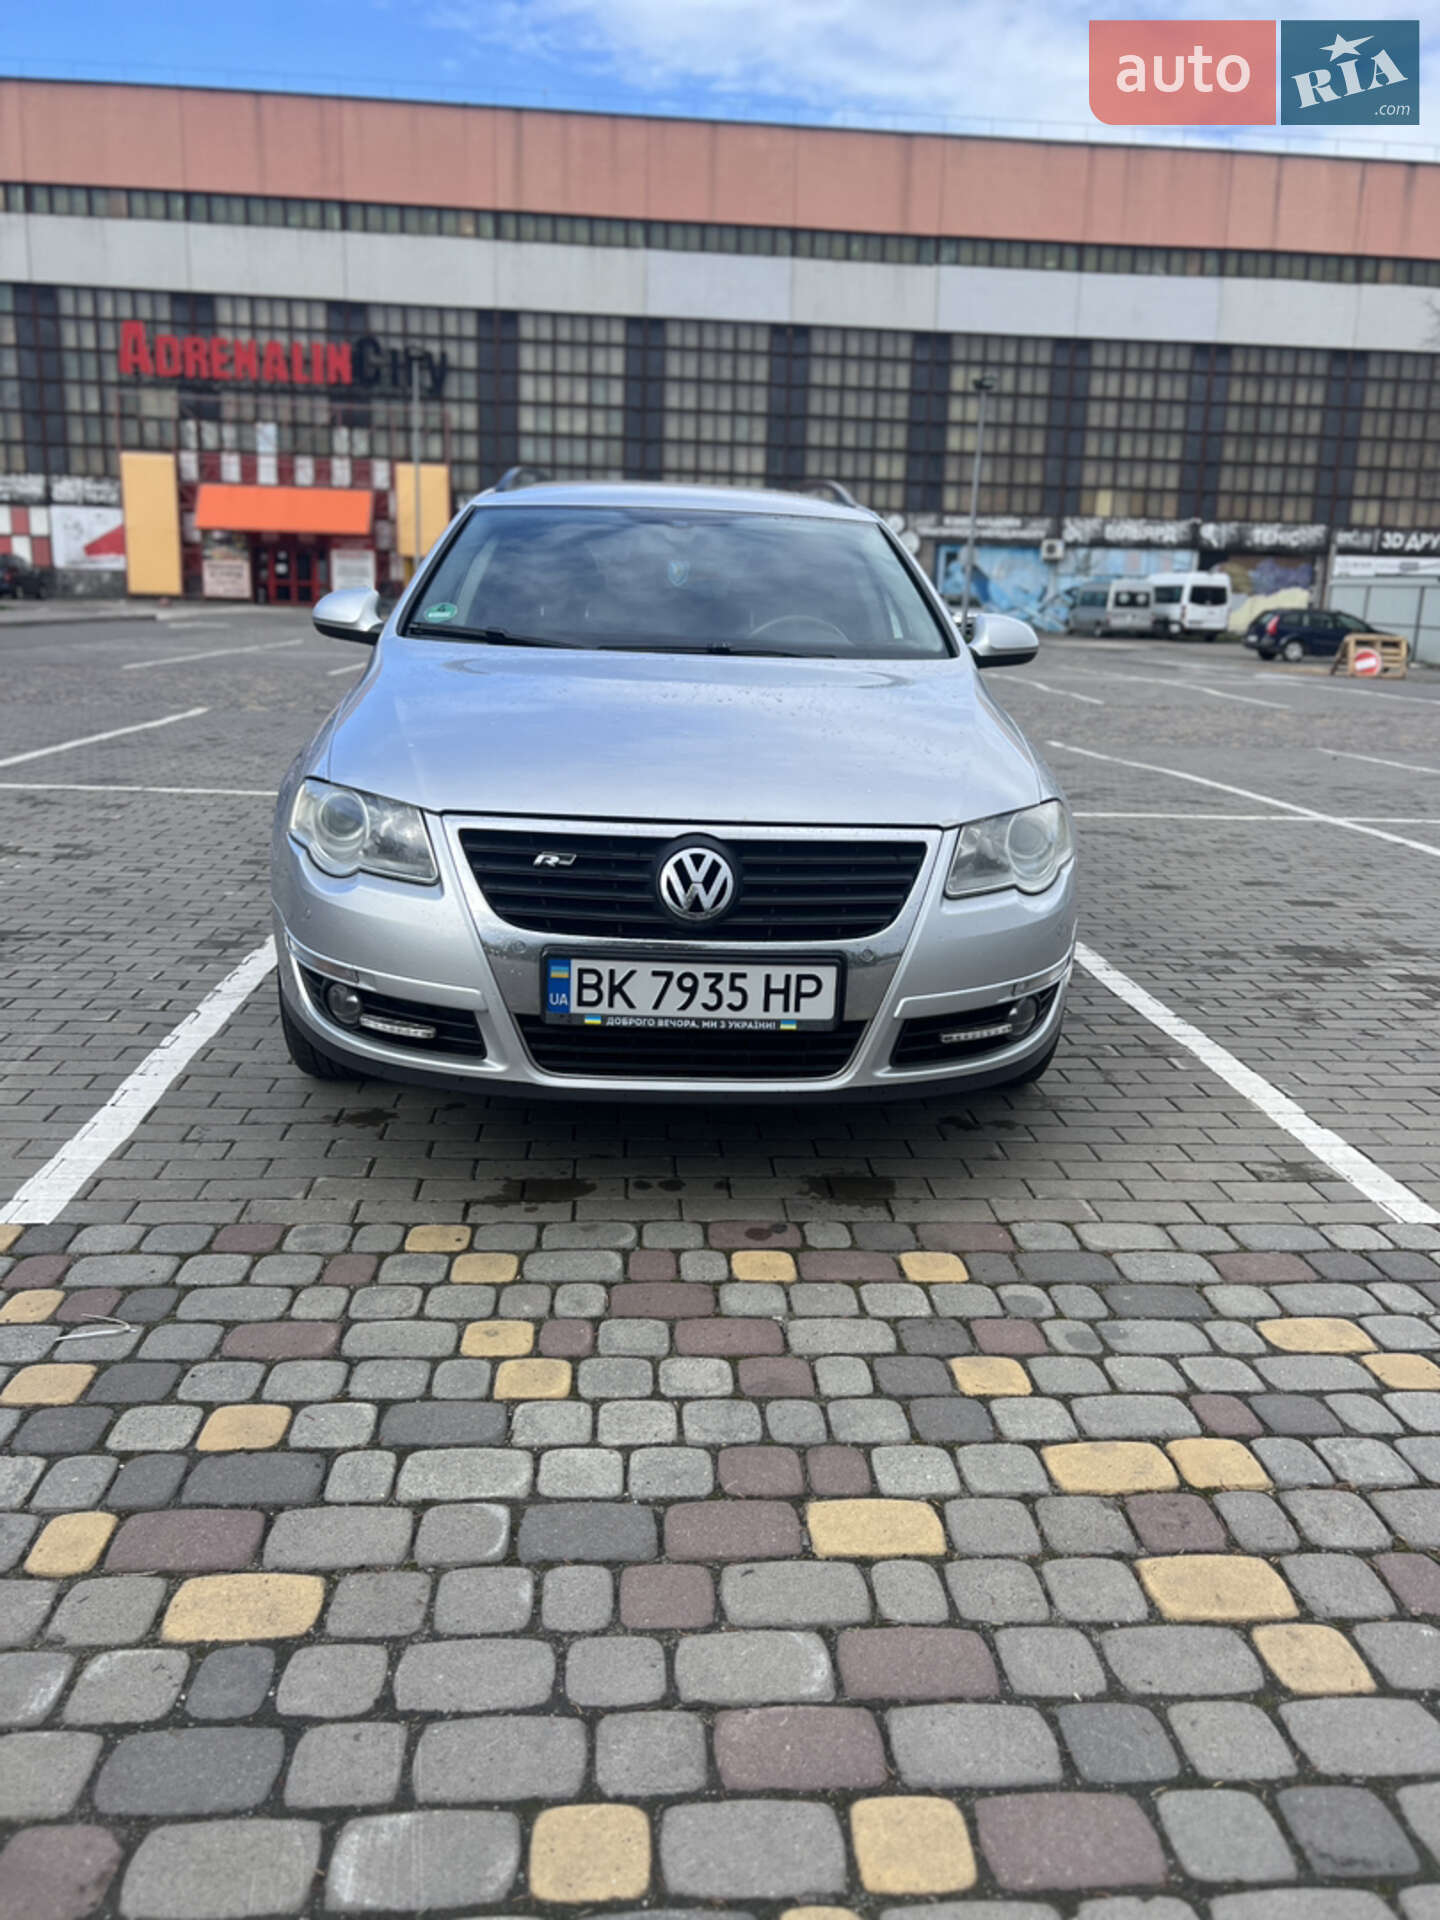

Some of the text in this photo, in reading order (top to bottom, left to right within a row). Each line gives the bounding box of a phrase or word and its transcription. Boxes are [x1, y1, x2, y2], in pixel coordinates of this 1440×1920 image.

[576, 968, 823, 1013] BK 7935 HP
[550, 993, 569, 1006] UA
[606, 1016, 655, 1027] ДОБРОГО
